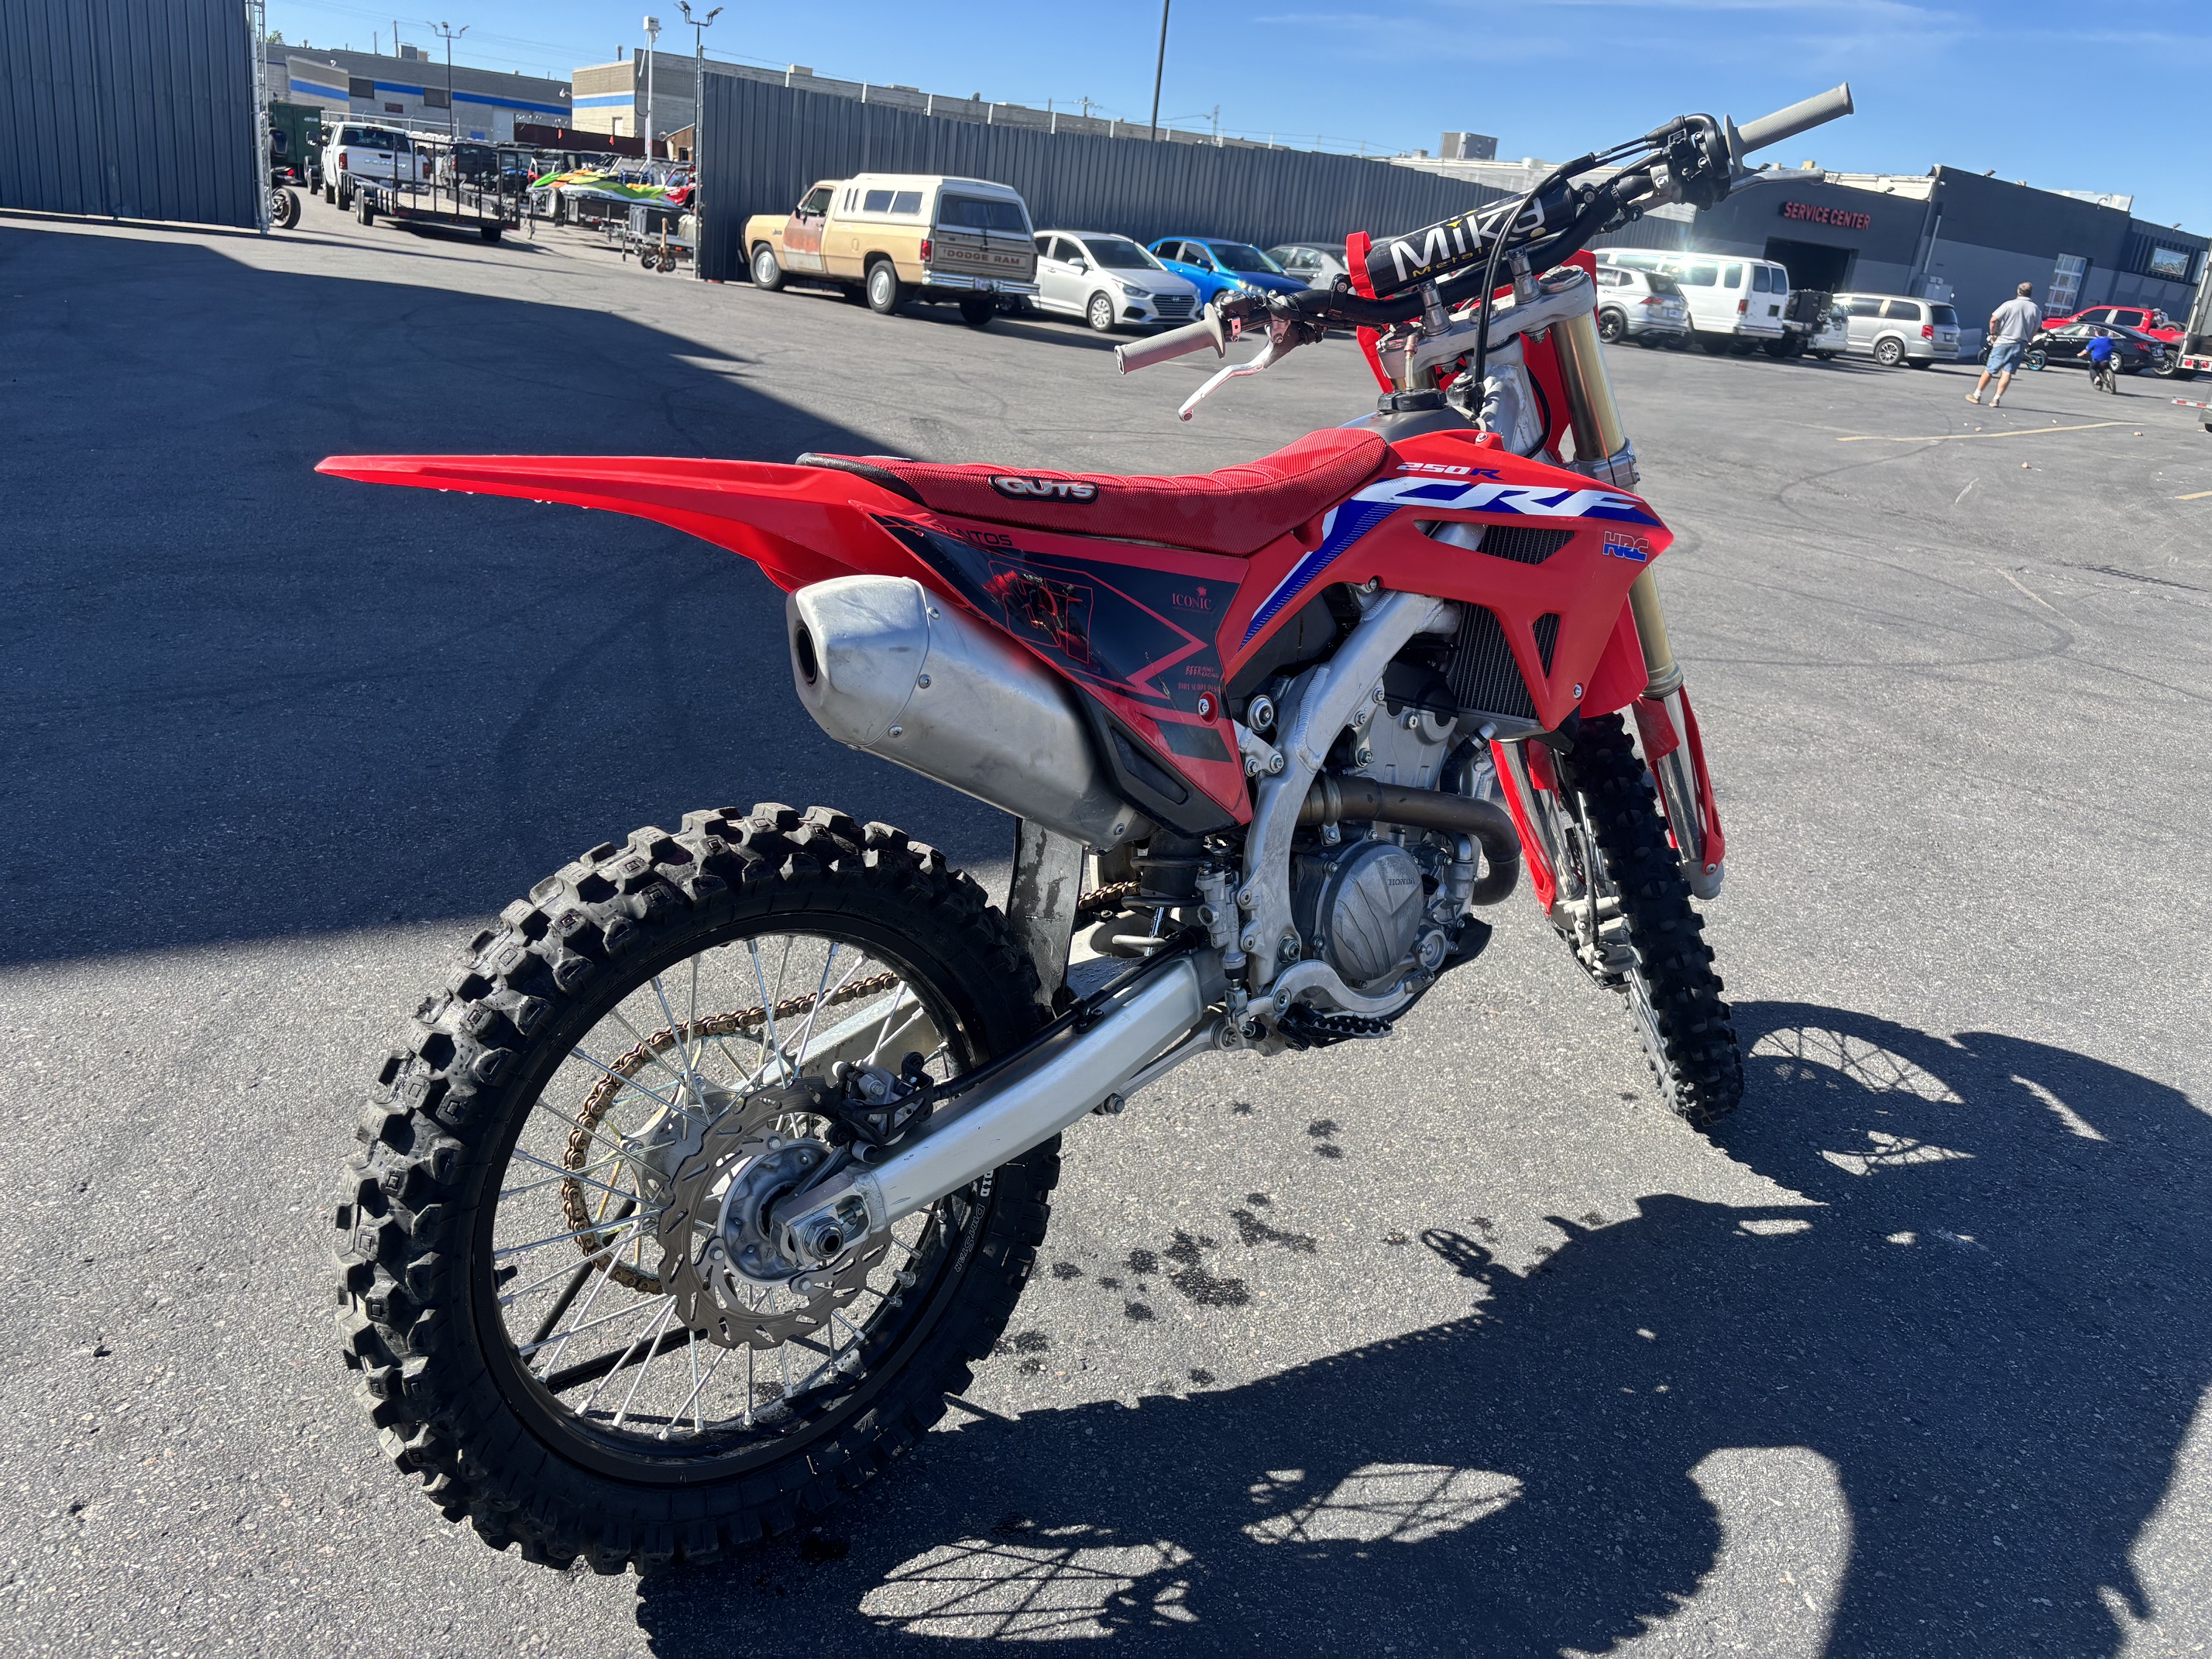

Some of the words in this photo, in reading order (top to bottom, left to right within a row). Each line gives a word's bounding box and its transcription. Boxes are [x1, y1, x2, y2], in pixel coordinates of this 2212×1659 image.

[1784, 201, 1830, 224] SERVICE
[1830, 208, 1871, 230] CENTER
[946, 249, 988, 262] DODGE
[994, 255, 1020, 265] RAM
[1412, 245, 1495, 278] Metal
[1396, 462, 1506, 481] 250R
[994, 476, 1096, 500] GUTS
[1352, 476, 1644, 517] CRF
[1602, 531, 1649, 562] HRC
[1172, 592, 1211, 610] ICONIC
[1185, 665, 1202, 676] BEER
[1388, 878, 1416, 886] HONDA
